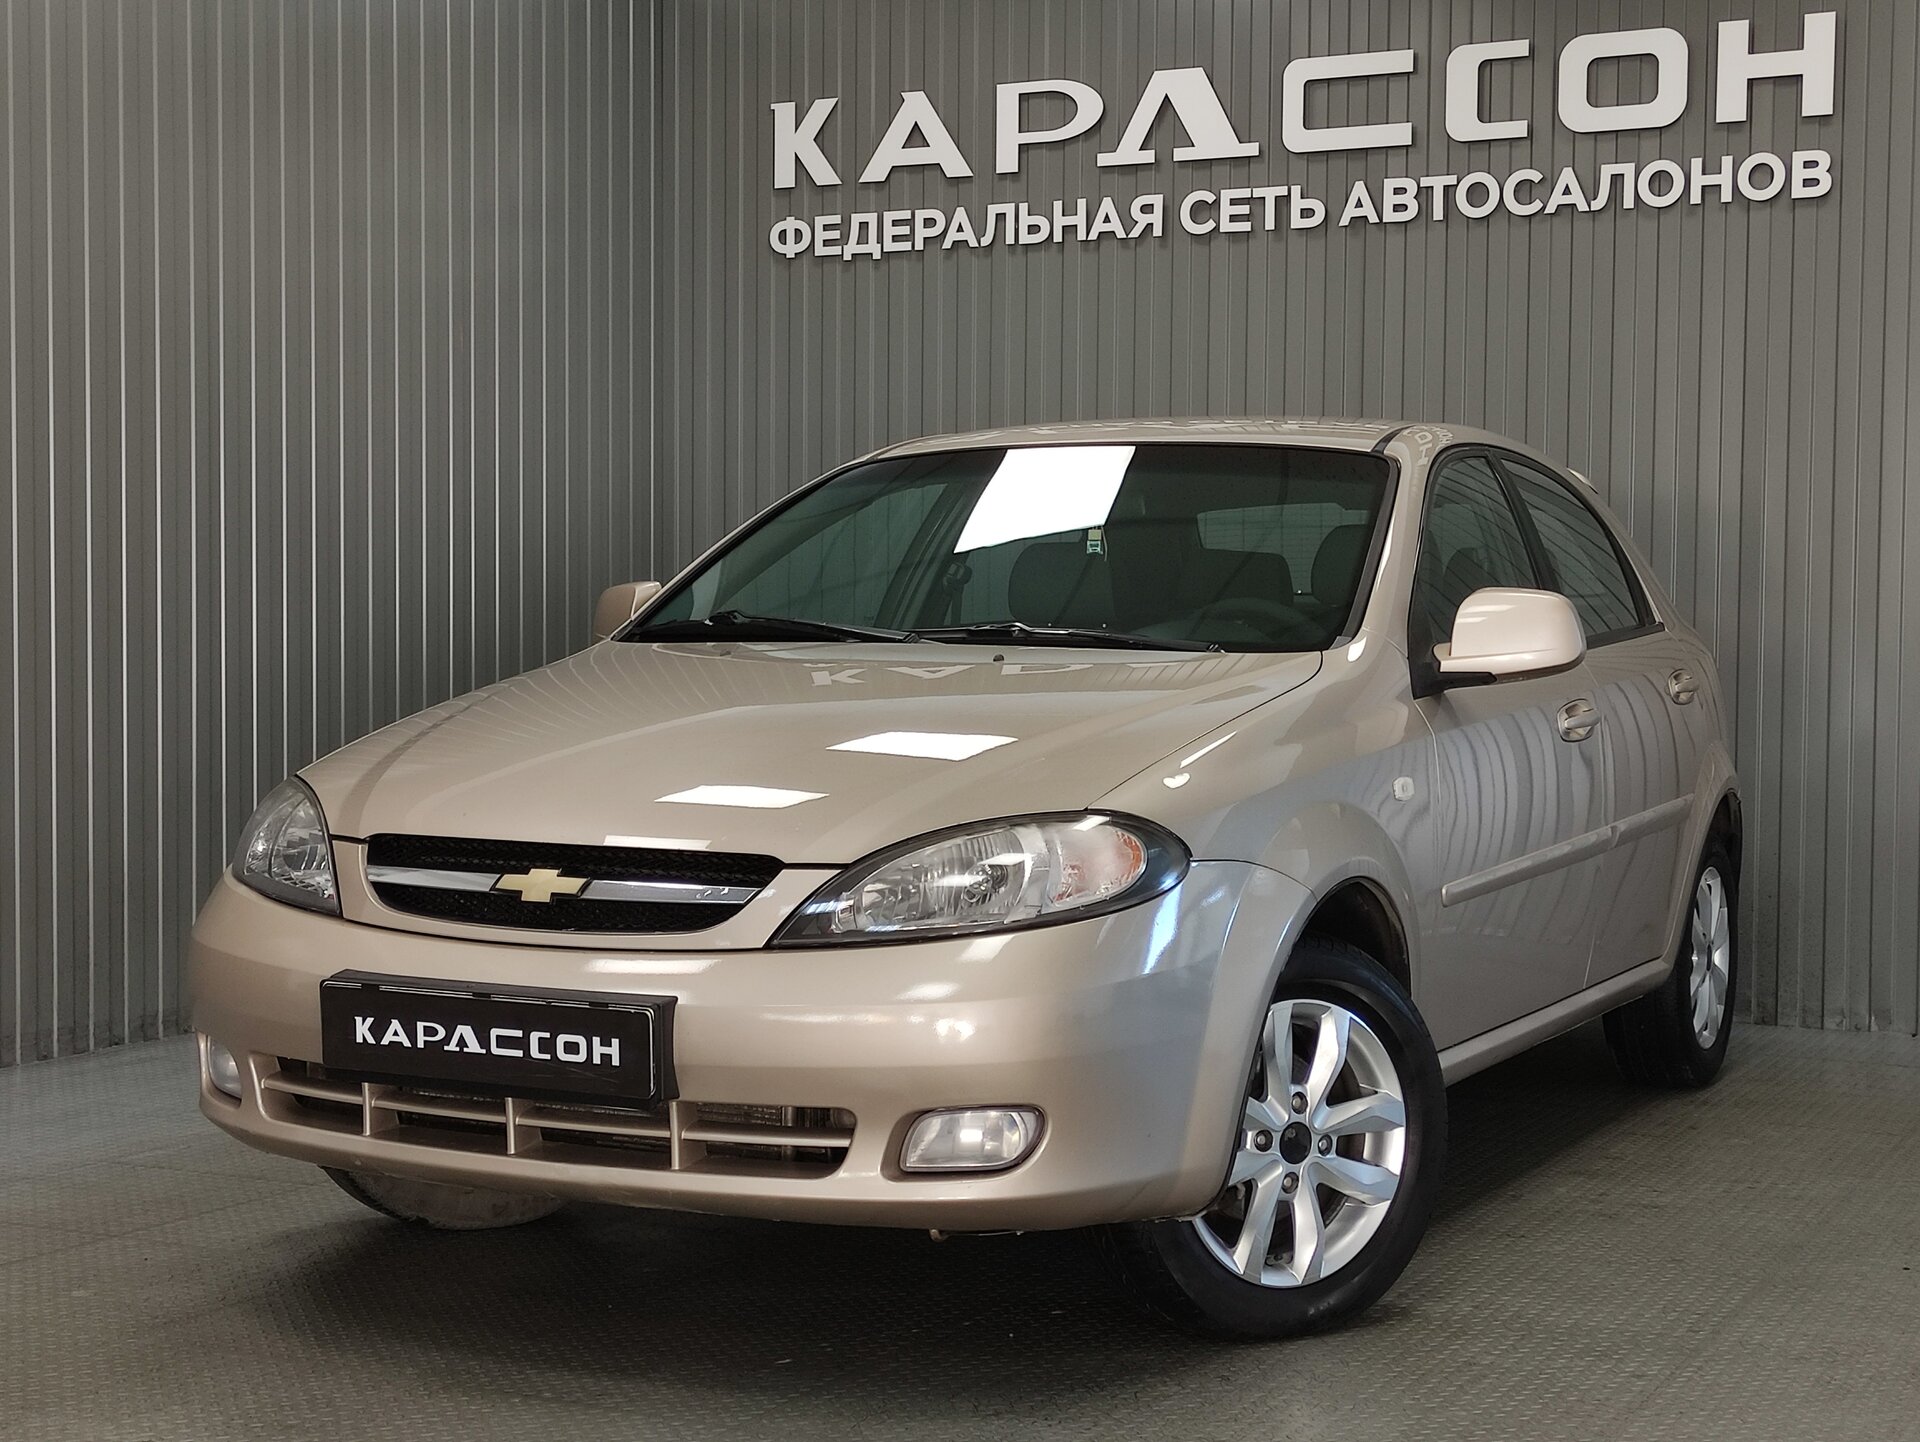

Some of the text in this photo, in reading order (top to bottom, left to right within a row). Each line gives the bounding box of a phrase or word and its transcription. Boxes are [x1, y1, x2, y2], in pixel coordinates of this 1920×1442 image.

[769, 149, 1833, 261] ФЕДЕРАЛЬНАЯ СЕТЬ АВТОСАЛОНОВ
